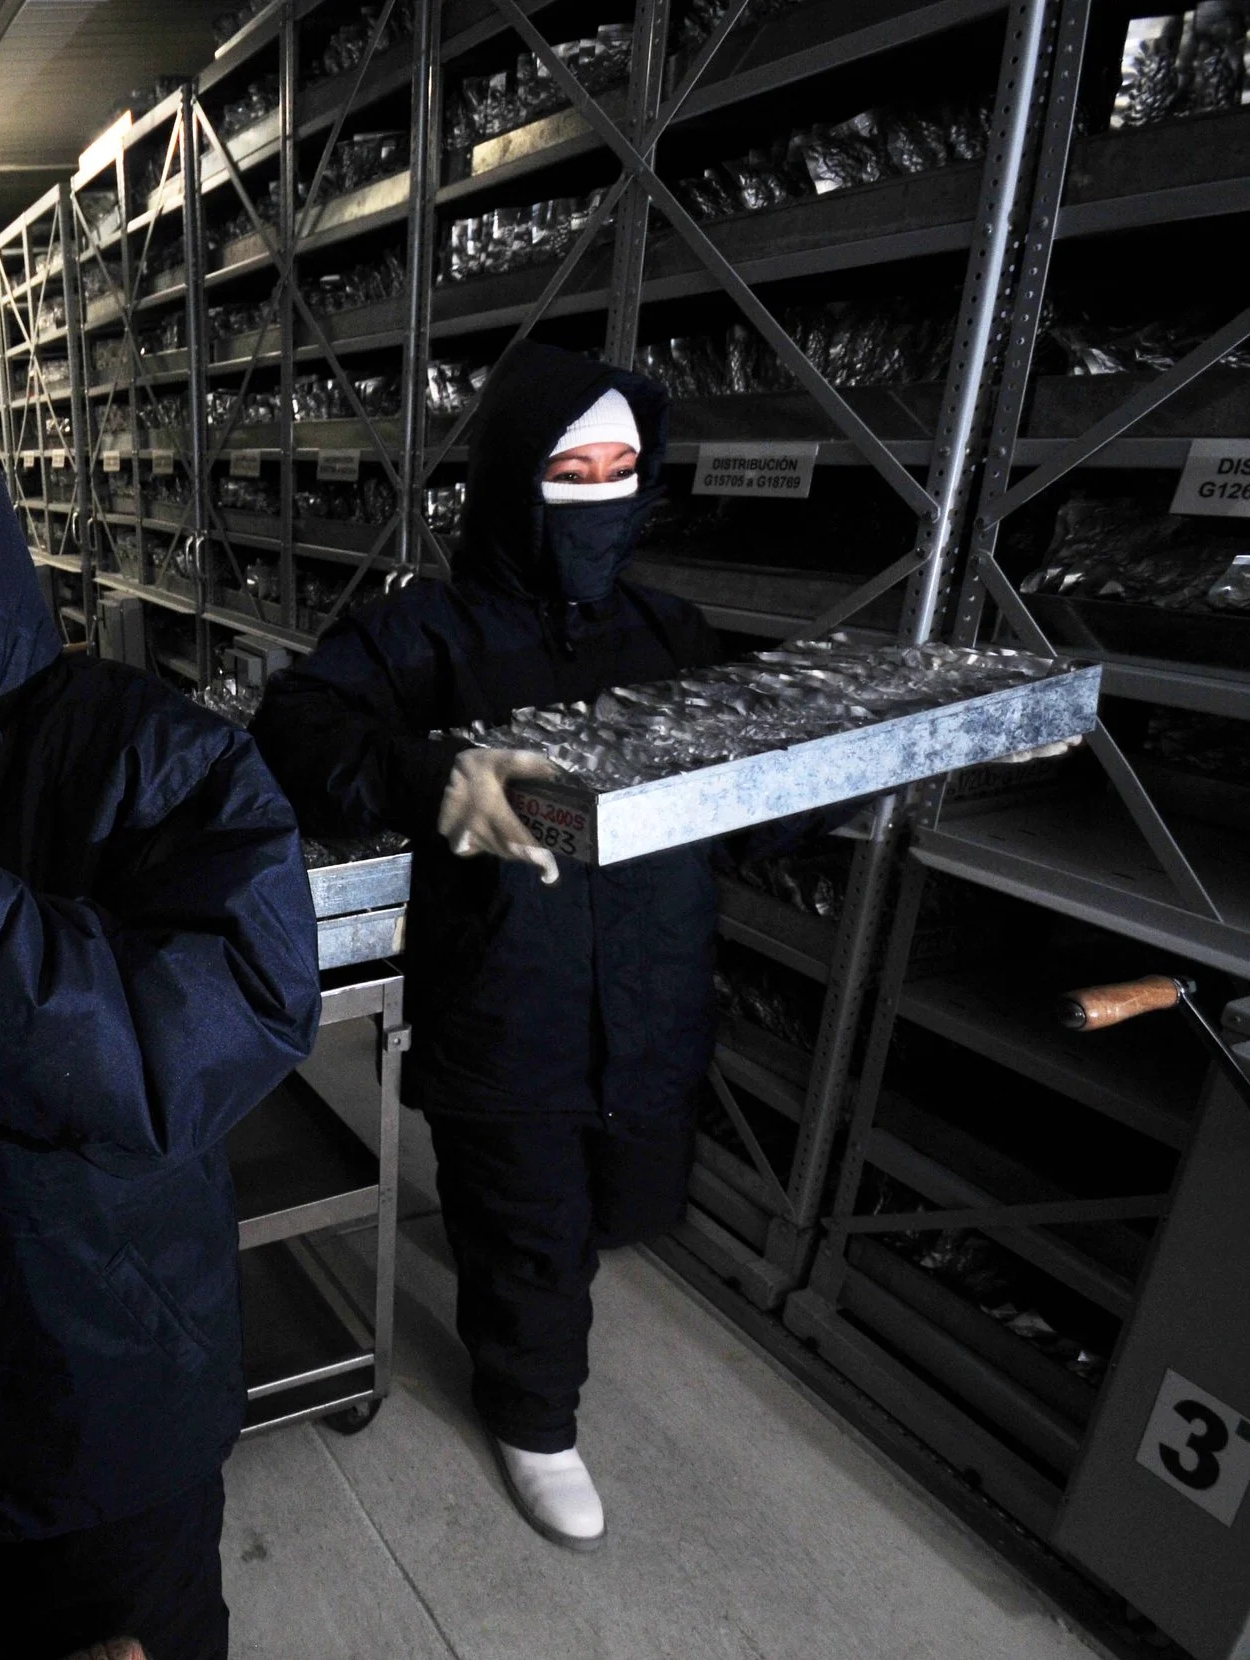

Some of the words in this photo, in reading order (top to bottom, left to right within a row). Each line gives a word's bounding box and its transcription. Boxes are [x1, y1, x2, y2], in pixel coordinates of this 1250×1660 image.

[712, 455, 798, 471] DISTRIBUCIÓN
[746, 477, 754, 487] a
[1159, 1400, 1229, 1491] 3
